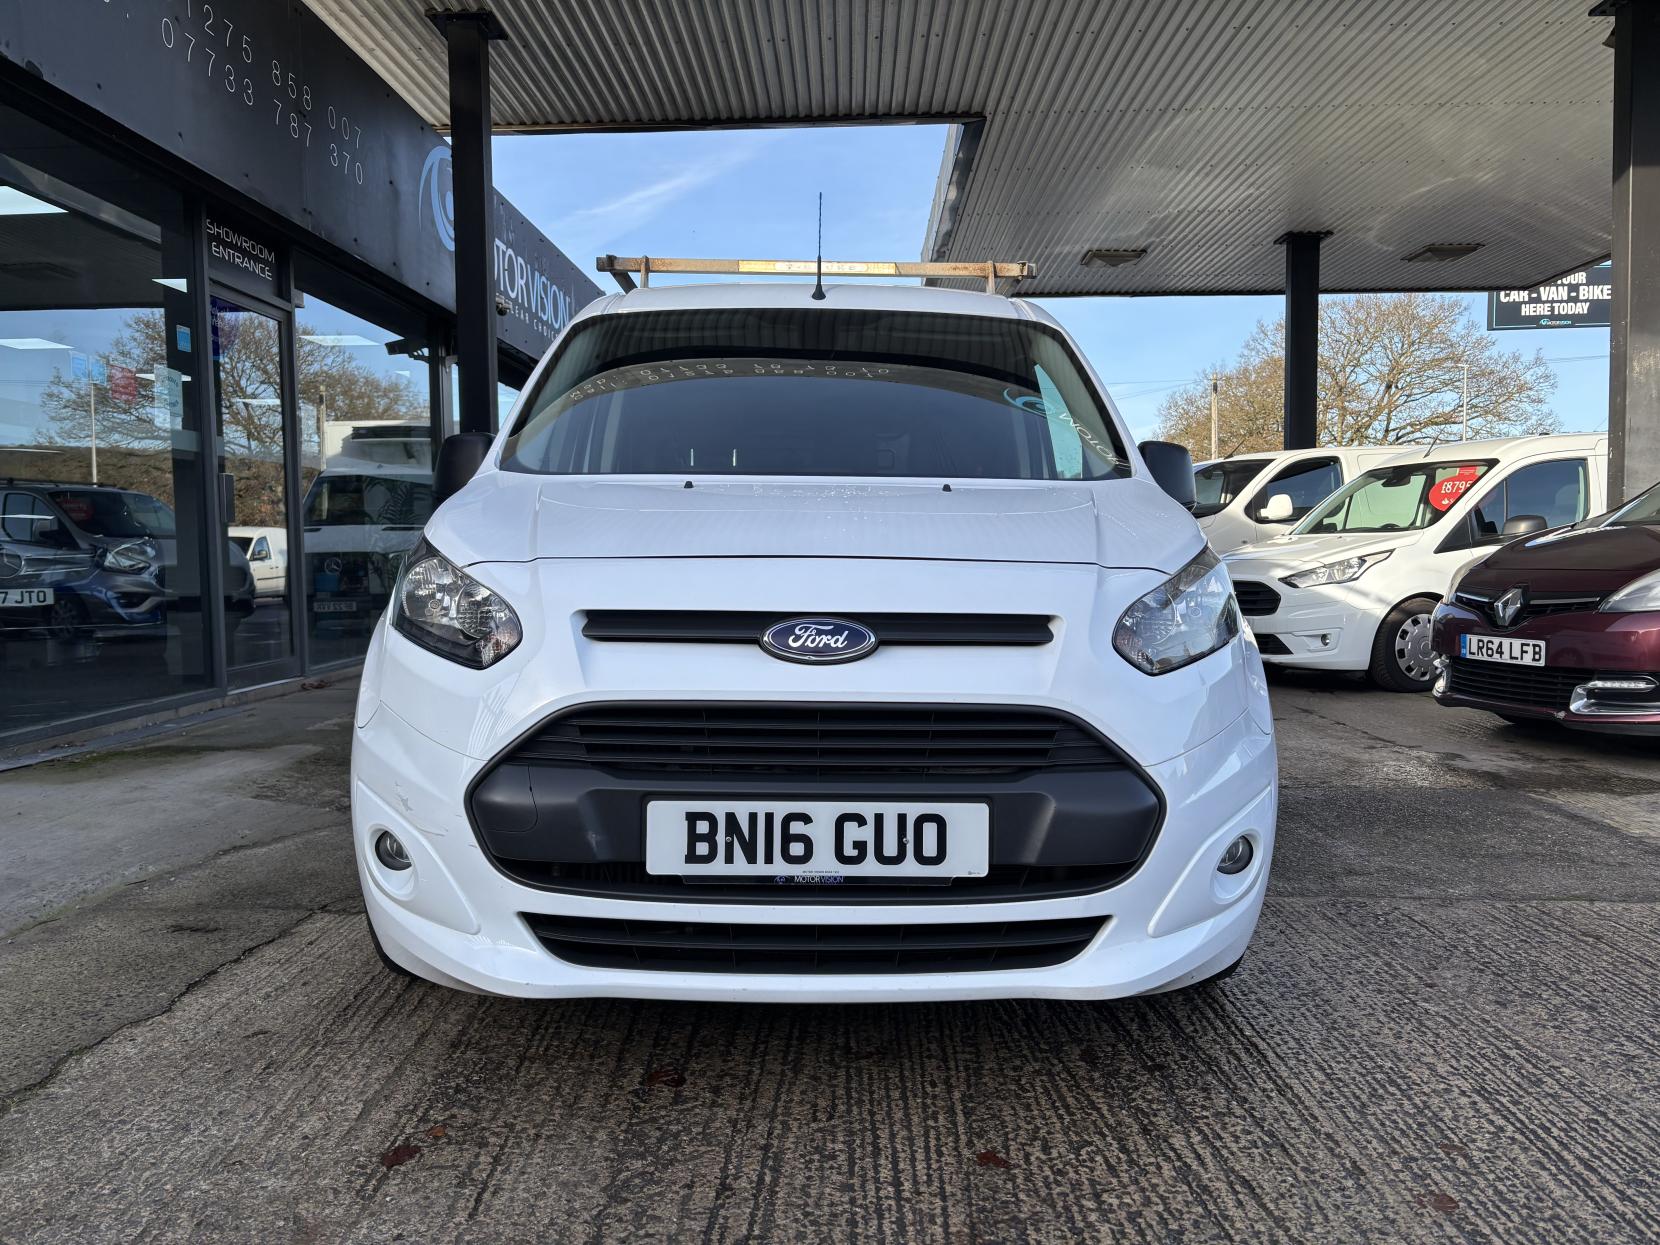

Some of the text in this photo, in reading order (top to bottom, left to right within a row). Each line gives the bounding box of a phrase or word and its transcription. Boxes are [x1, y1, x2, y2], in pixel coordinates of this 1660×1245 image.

[161, 18, 363, 185] 07733 787 370
[272, 60, 312, 111] 858
[328, 106, 361, 149] 007
[206, 219, 275, 263] SHOWROOM
[211, 241, 273, 281] ENTRANCE
[1556, 271, 1587, 285] OUR
[1500, 290, 1529, 303] CAR
[1540, 286, 1568, 301] VAN
[1578, 284, 1612, 300] BIKE
[507, 303, 530, 324] LEAR
[1521, 302, 1590, 316] HERE TODAY
[14, 590, 47, 604] JTO
[788, 624, 849, 648] Ford
[1468, 637, 1542, 662] LR64 LFB
[684, 811, 947, 866] BN16 GUO
